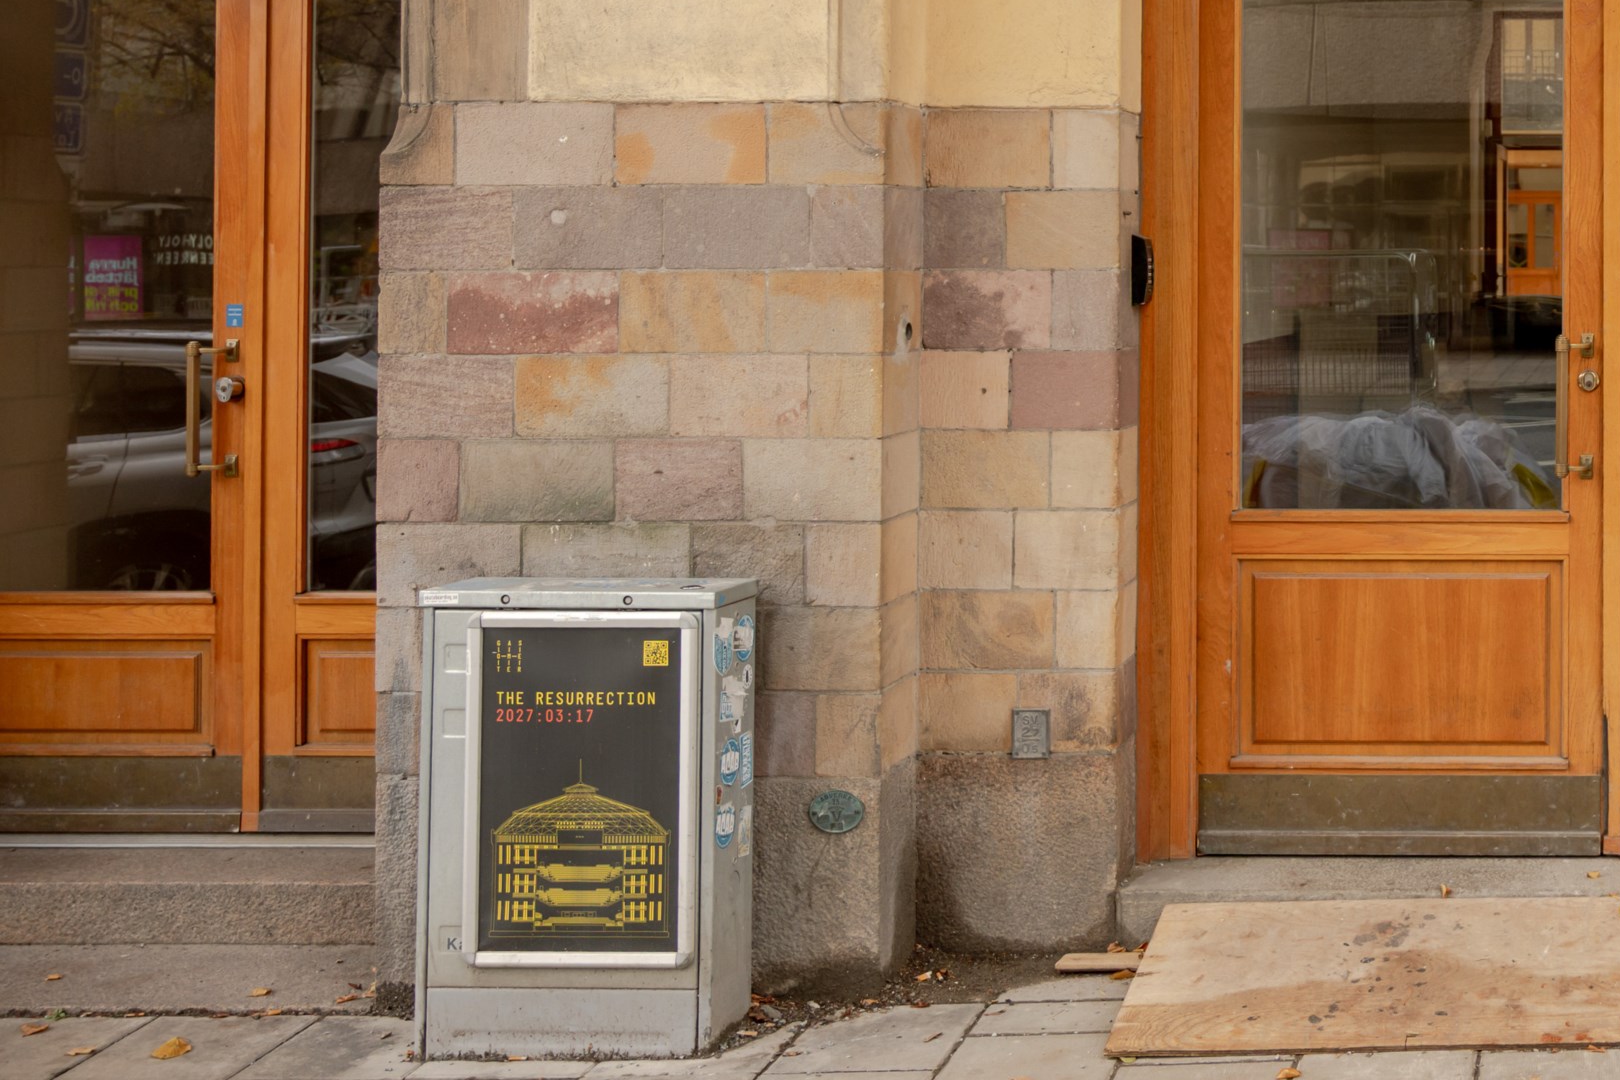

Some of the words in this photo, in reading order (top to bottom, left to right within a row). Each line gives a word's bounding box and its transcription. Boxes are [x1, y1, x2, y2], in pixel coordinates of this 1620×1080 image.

[496, 691, 524, 705] THE
[535, 691, 657, 706] RESURRECTION
[496, 708, 594, 723] 2027:03:17
